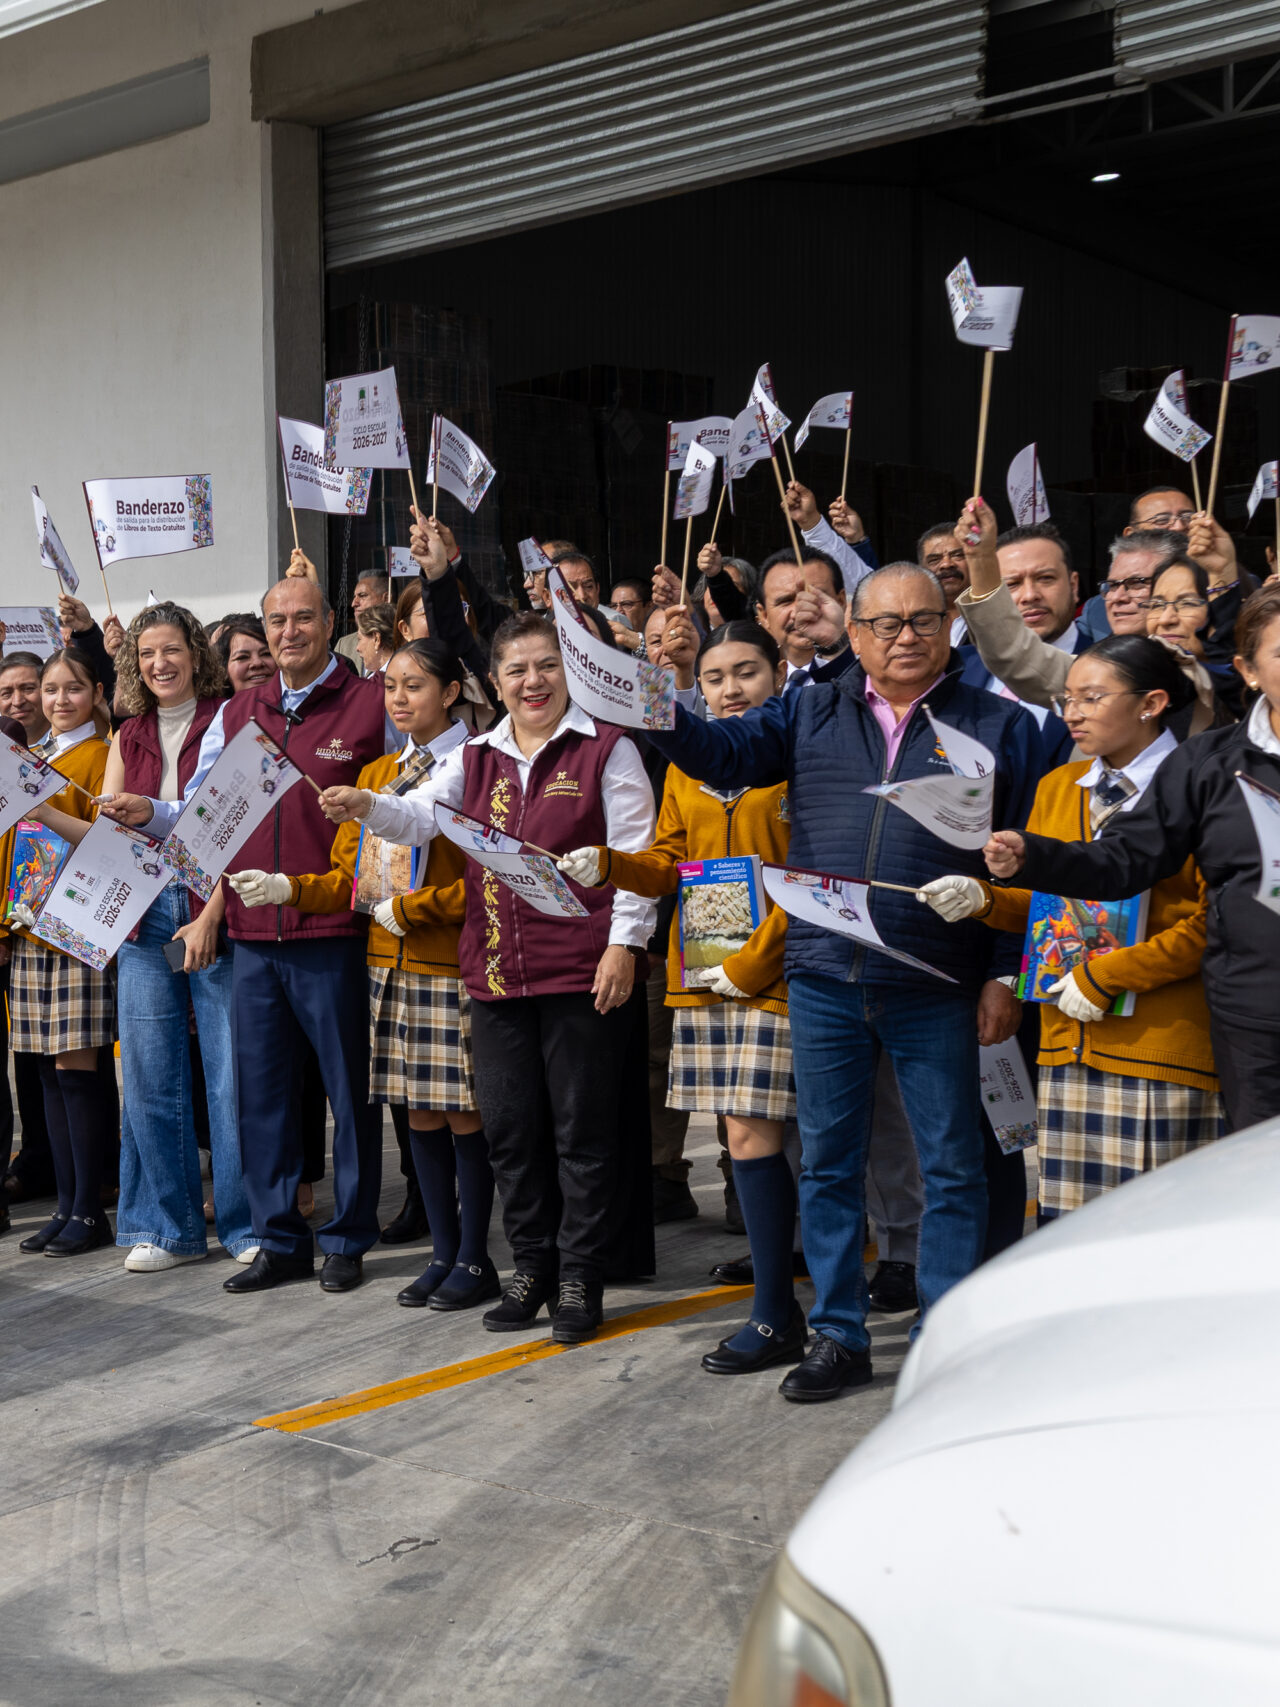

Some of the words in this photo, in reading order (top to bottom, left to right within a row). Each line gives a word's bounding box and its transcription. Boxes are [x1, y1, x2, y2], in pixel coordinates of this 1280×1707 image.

[353, 431, 388, 449] 2026-2027
[291, 444, 345, 475] Bandeazo
[116, 498, 185, 516] Banderazo
[124, 524, 139, 532] Libros
[140, 524, 147, 532] de
[5, 621, 44, 633] anderazo
[560, 625, 634, 693] Banderazo
[584, 679, 600, 695] Texto
[316, 747, 353, 757] HIDALGO
[211, 823, 226, 843] CICLO
[223, 795, 244, 824] ESCOLAR
[216, 800, 250, 851] 2026-2027
[93, 903, 107, 921] CICLO
[102, 877, 121, 905] ESCOLAR
[102, 882, 132, 929] 2026-2027
